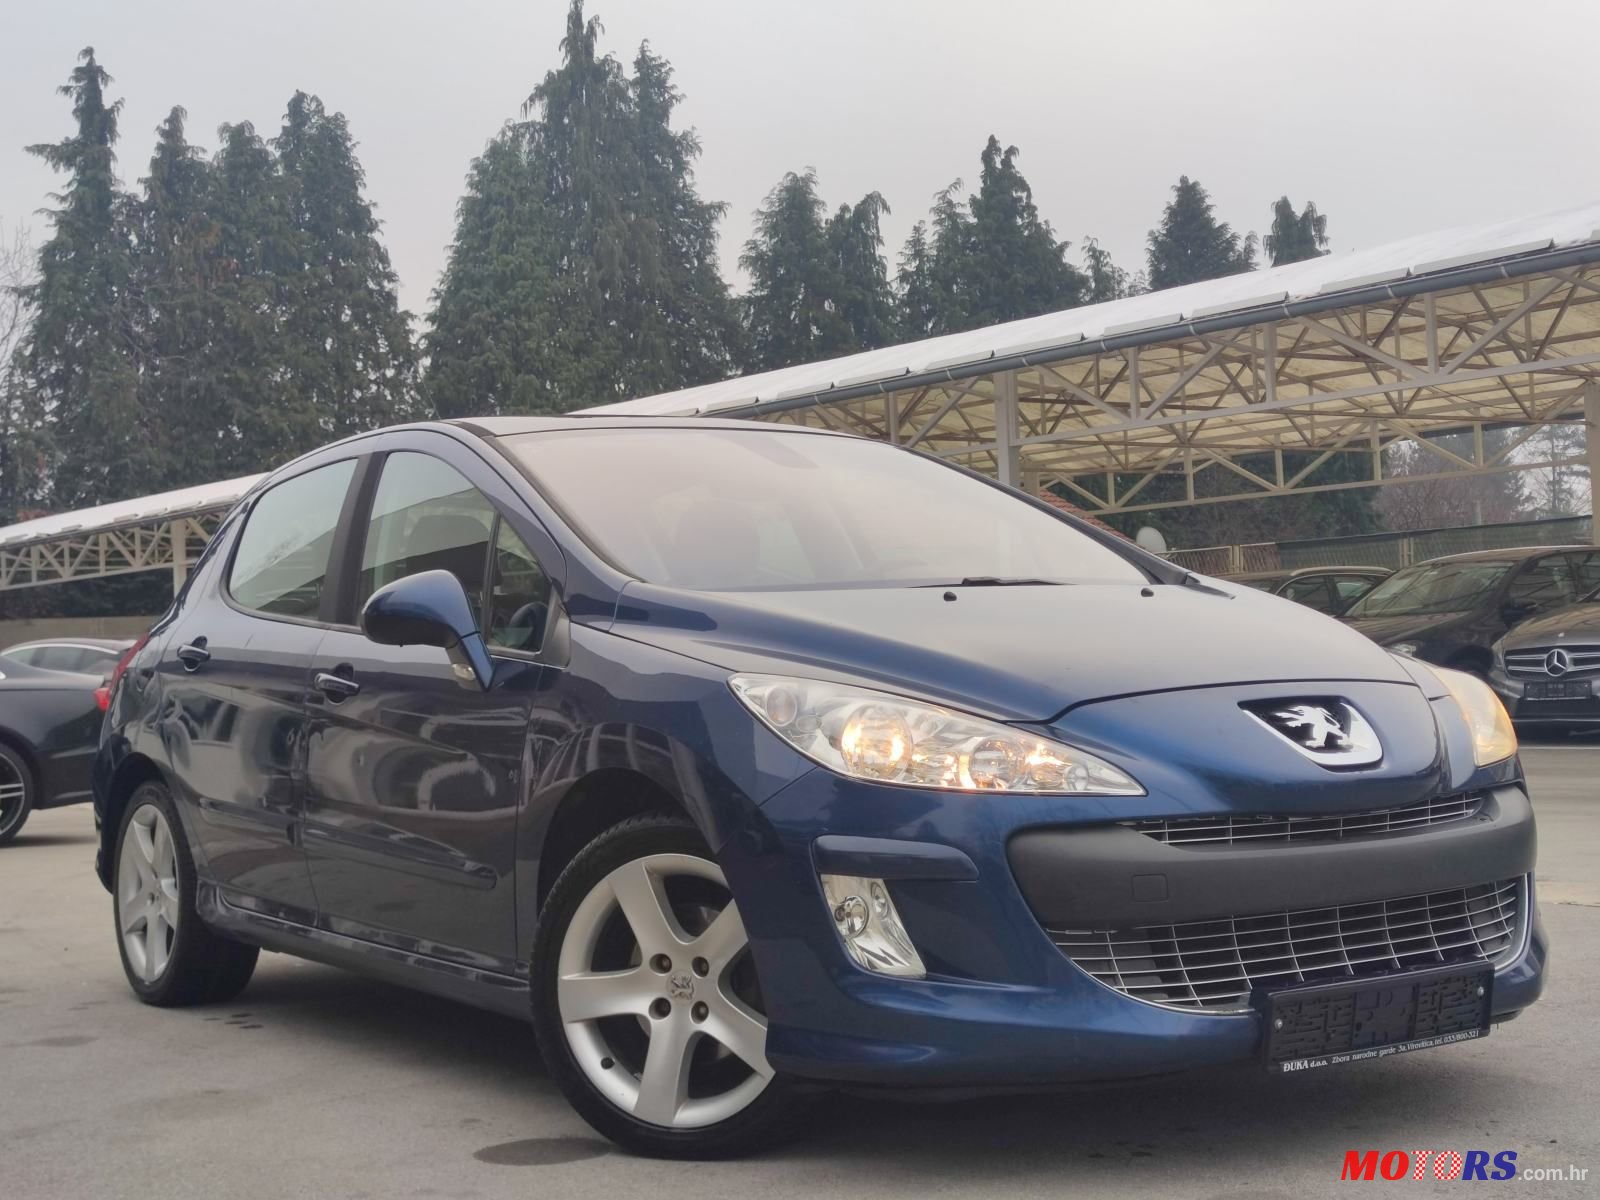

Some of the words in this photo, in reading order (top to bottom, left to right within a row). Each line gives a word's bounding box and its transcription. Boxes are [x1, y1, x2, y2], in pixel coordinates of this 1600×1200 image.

[1283, 1060, 1309, 1072] ĐUKA
[1332, 1056, 1350, 1064] Zbora
[1352, 1051, 1377, 1060] narodne
[1379, 1047, 1397, 1057] garde
